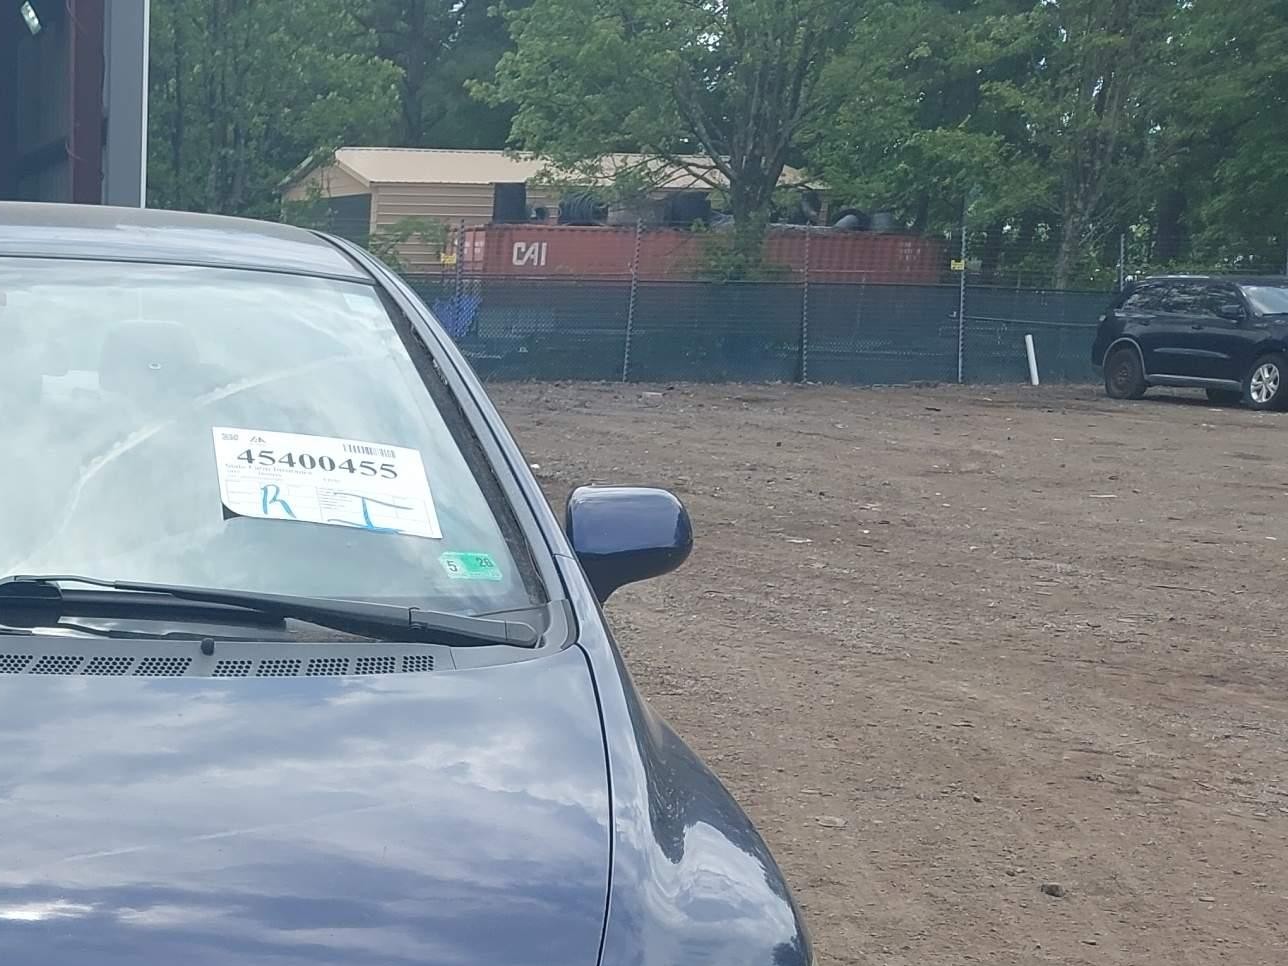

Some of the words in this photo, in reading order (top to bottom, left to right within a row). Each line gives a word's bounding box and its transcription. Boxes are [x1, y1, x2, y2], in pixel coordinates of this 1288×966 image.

[512, 242, 548, 266] CAI
[237, 449, 398, 479] 45400455
[446, 560, 458, 572] 5
